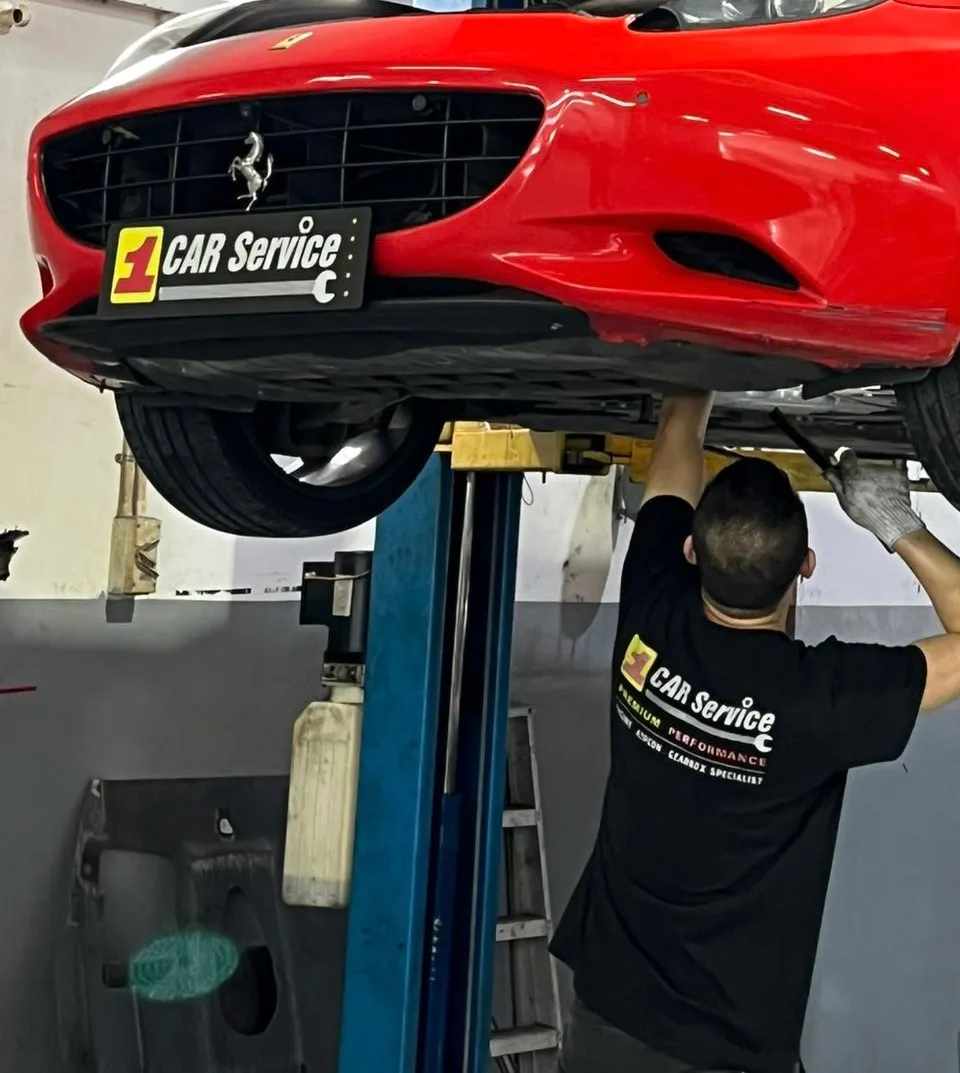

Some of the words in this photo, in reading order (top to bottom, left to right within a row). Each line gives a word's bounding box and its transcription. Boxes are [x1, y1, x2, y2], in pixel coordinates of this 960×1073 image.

[114, 236, 158, 294] 1
[162, 233, 226, 275] CAR
[227, 216, 341, 272] Service
[618, 683, 661, 728] PREMIUM
[668, 727, 767, 767] PERFORMANCE
[622, 651, 652, 684] 1
[649, 667, 691, 704] CAR
[691, 697, 776, 733] Service
[668, 750, 707, 774] GEARBOX
[709, 767, 763, 786] SPECIALIST
